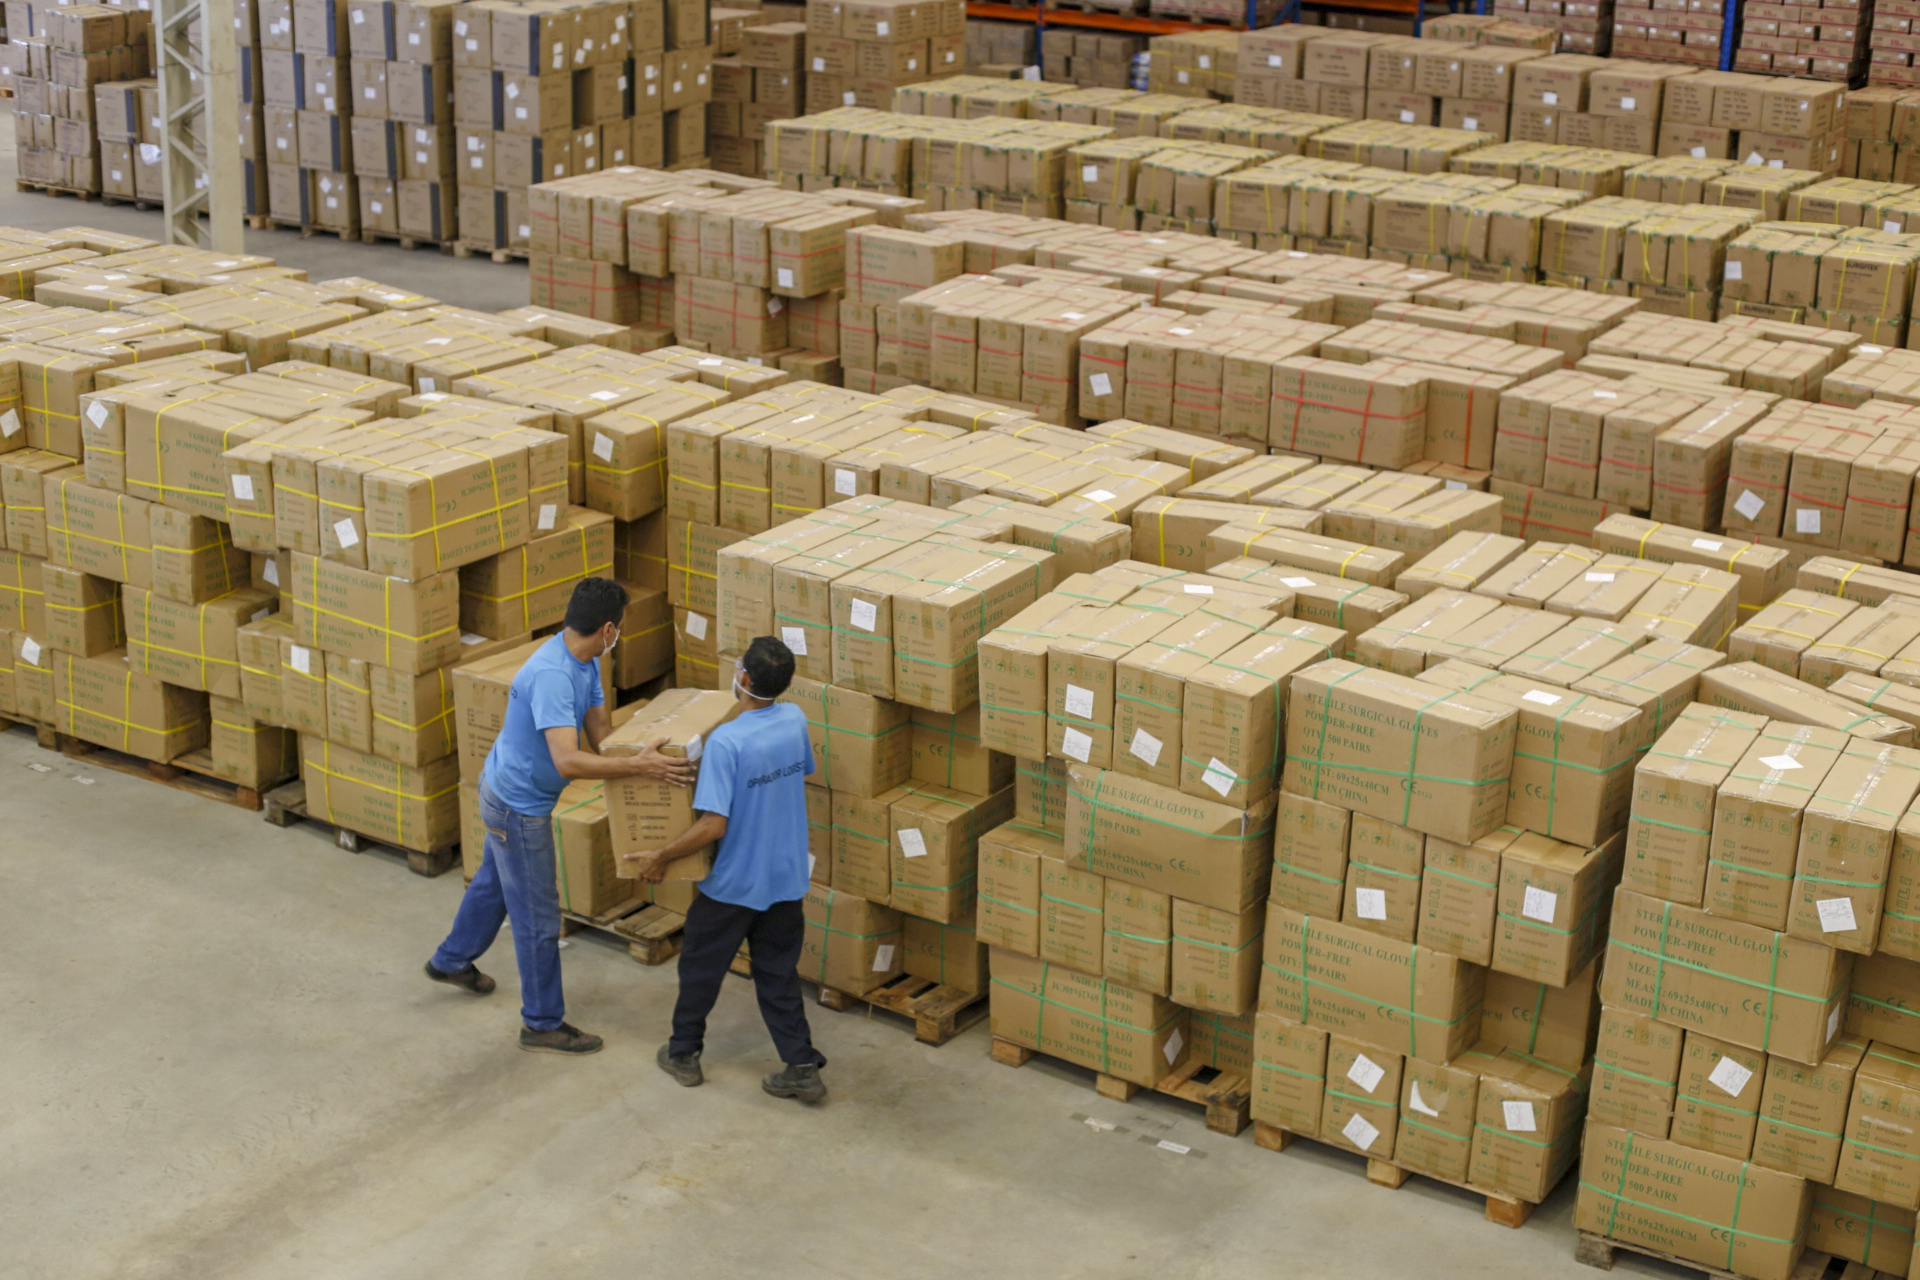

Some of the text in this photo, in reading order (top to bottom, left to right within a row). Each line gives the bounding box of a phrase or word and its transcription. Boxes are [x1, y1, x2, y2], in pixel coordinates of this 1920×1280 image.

[1845, 261, 1879, 272] SURGITEK
[1347, 703, 1397, 727] SURGICAL
[1327, 733, 1371, 754] 500 PAIRS
[1329, 752, 1334, 761] 7
[1327, 783, 1369, 804] IN CHINA
[1336, 771, 1389, 795] 69x25x40CM
[1118, 788, 1204, 820] SURGICAL GLOVES
[1099, 817, 1140, 837] 500 PAIRS
[1103, 834, 1107, 843] 7
[1106, 861, 1145, 880] IN CHINA
[1324, 933, 1374, 956] SURGICAL
[1682, 921, 1740, 946] SURGICAL
[1279, 953, 1348, 981] QTY: PAIRS
[1627, 960, 1655, 976] SIZE:
[1069, 972, 1096, 988] CHINA
[1667, 989, 1729, 1016] 69x25x40CM
[1315, 1010, 1346, 1028] CHINA
[1668, 1004, 1705, 1025] CHINA
[1053, 1038, 1095, 1060] SURGICAL
[1653, 1151, 1709, 1176] SURGICAL
[1627, 1179, 1645, 1193] 500
[1646, 1185, 1678, 1204] PAIRS
[1627, 1225, 1639, 1237] IN
[1640, 1228, 1675, 1248] CHINA
[1637, 1214, 1698, 1243] 69x25x40CM
